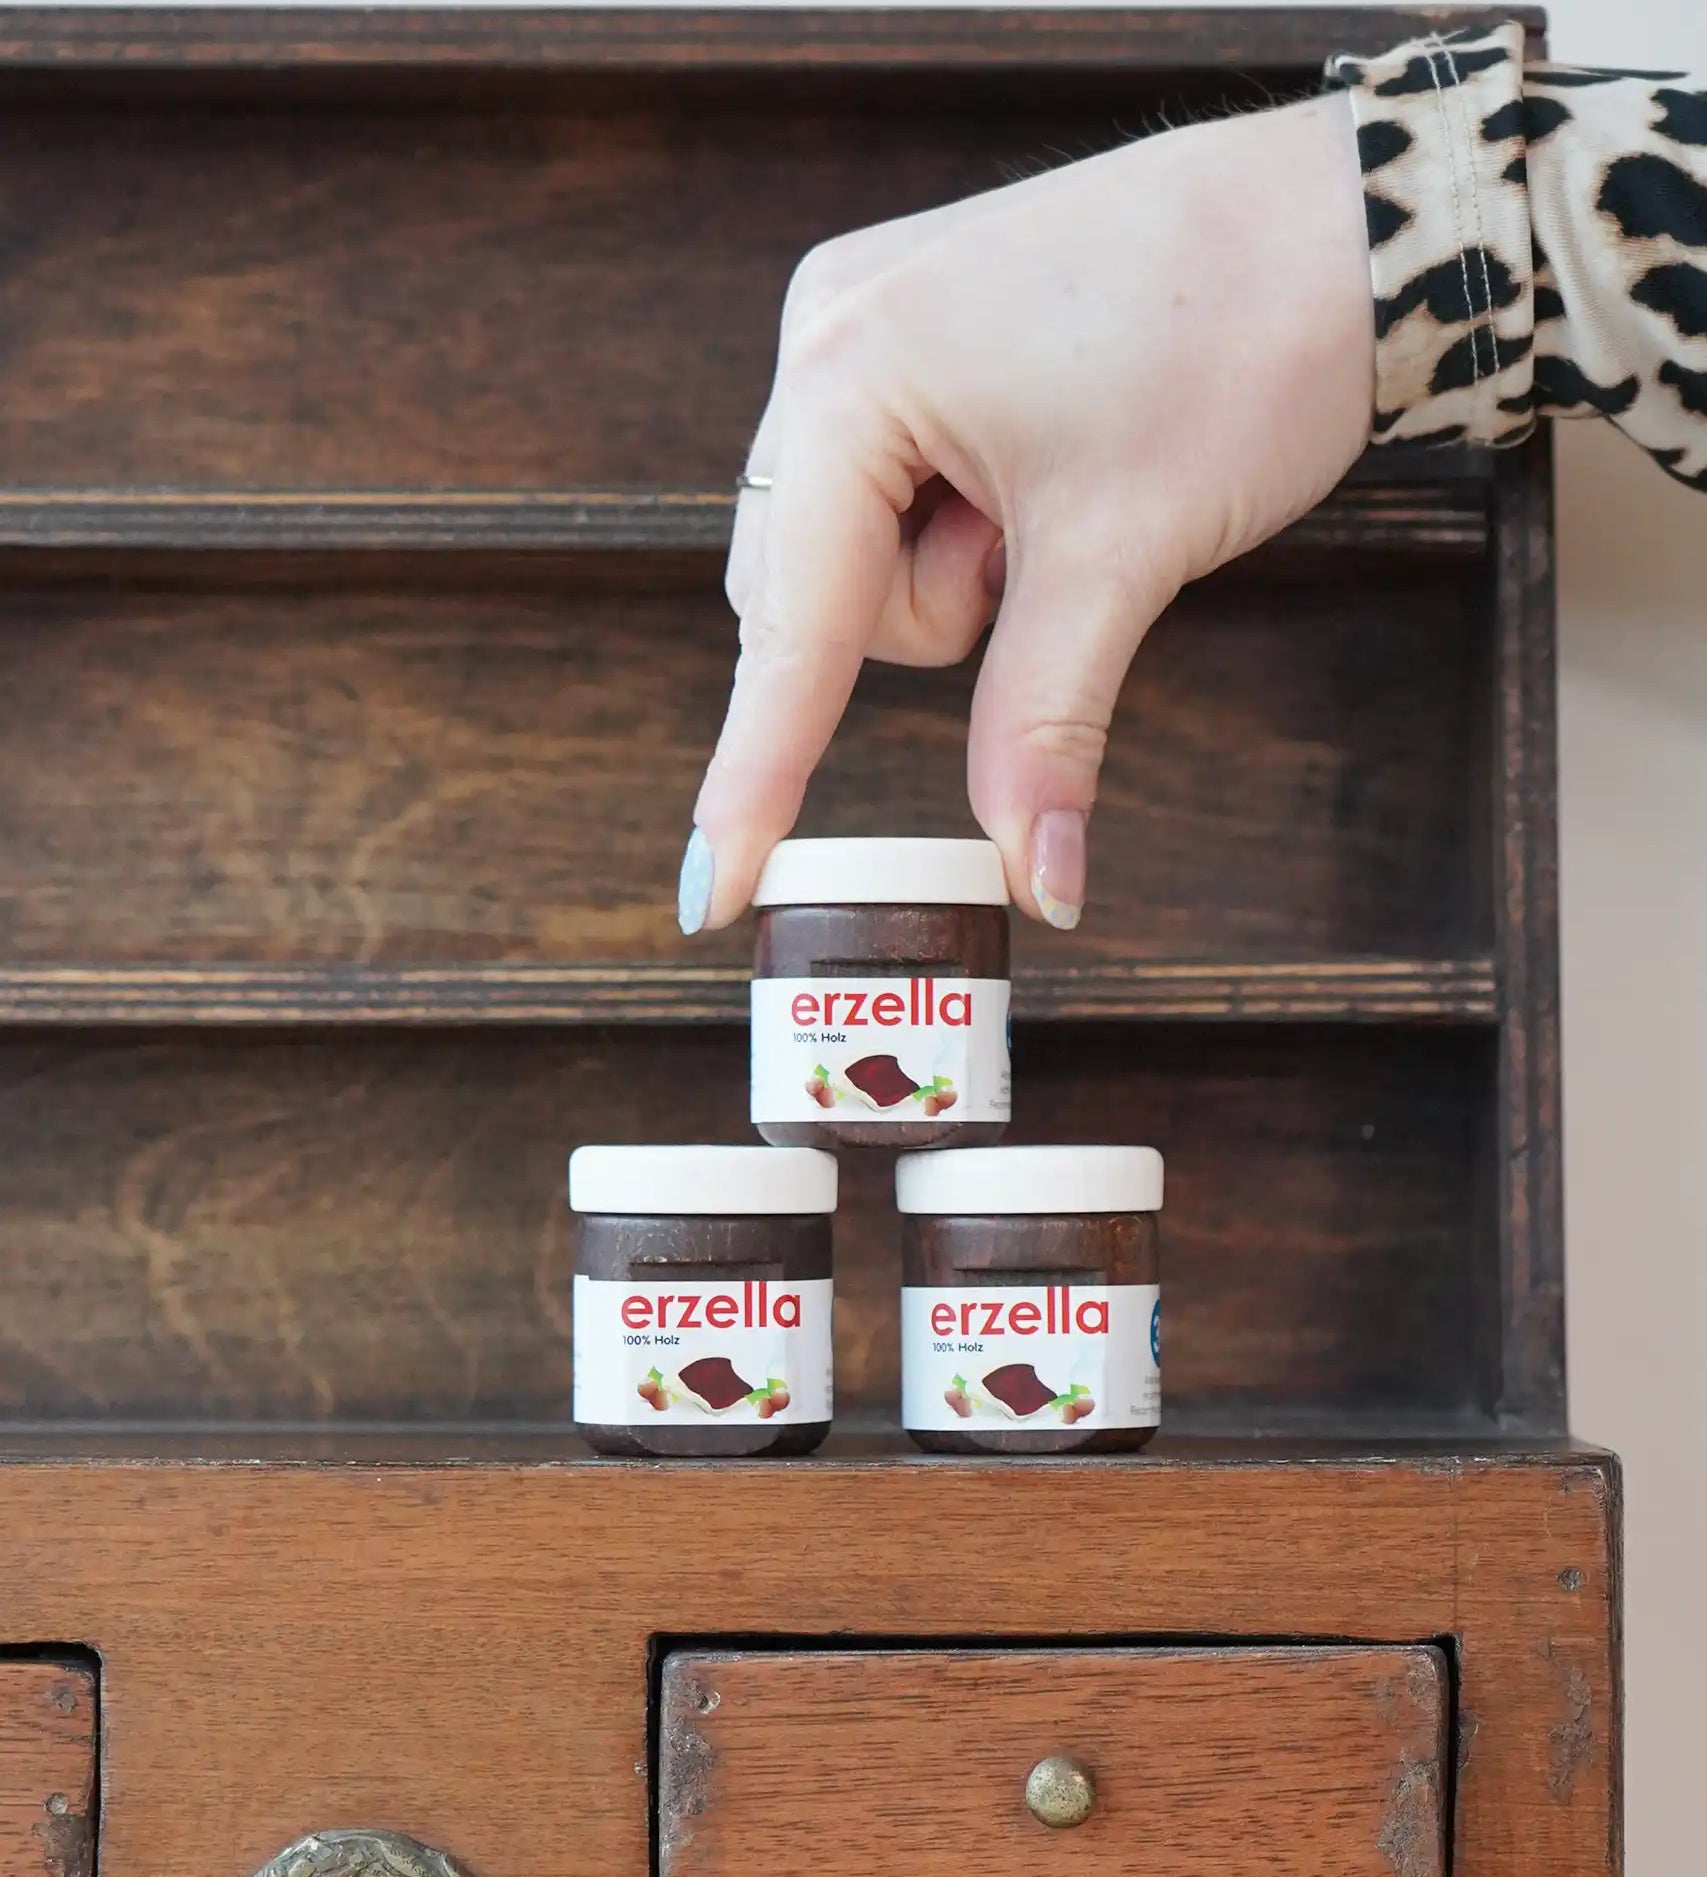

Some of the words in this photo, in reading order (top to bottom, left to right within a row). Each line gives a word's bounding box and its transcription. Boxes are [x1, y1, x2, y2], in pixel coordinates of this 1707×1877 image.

[791, 978, 972, 1027] erzella
[793, 1032, 818, 1043] 100%
[821, 1032, 847, 1043] Holz
[621, 1281, 801, 1329] erzella
[931, 1286, 1109, 1336] erzella
[623, 1334, 651, 1346] 100%
[654, 1334, 680, 1346] Holz
[933, 1342, 955, 1353] 100%
[958, 1342, 984, 1353] Holz
